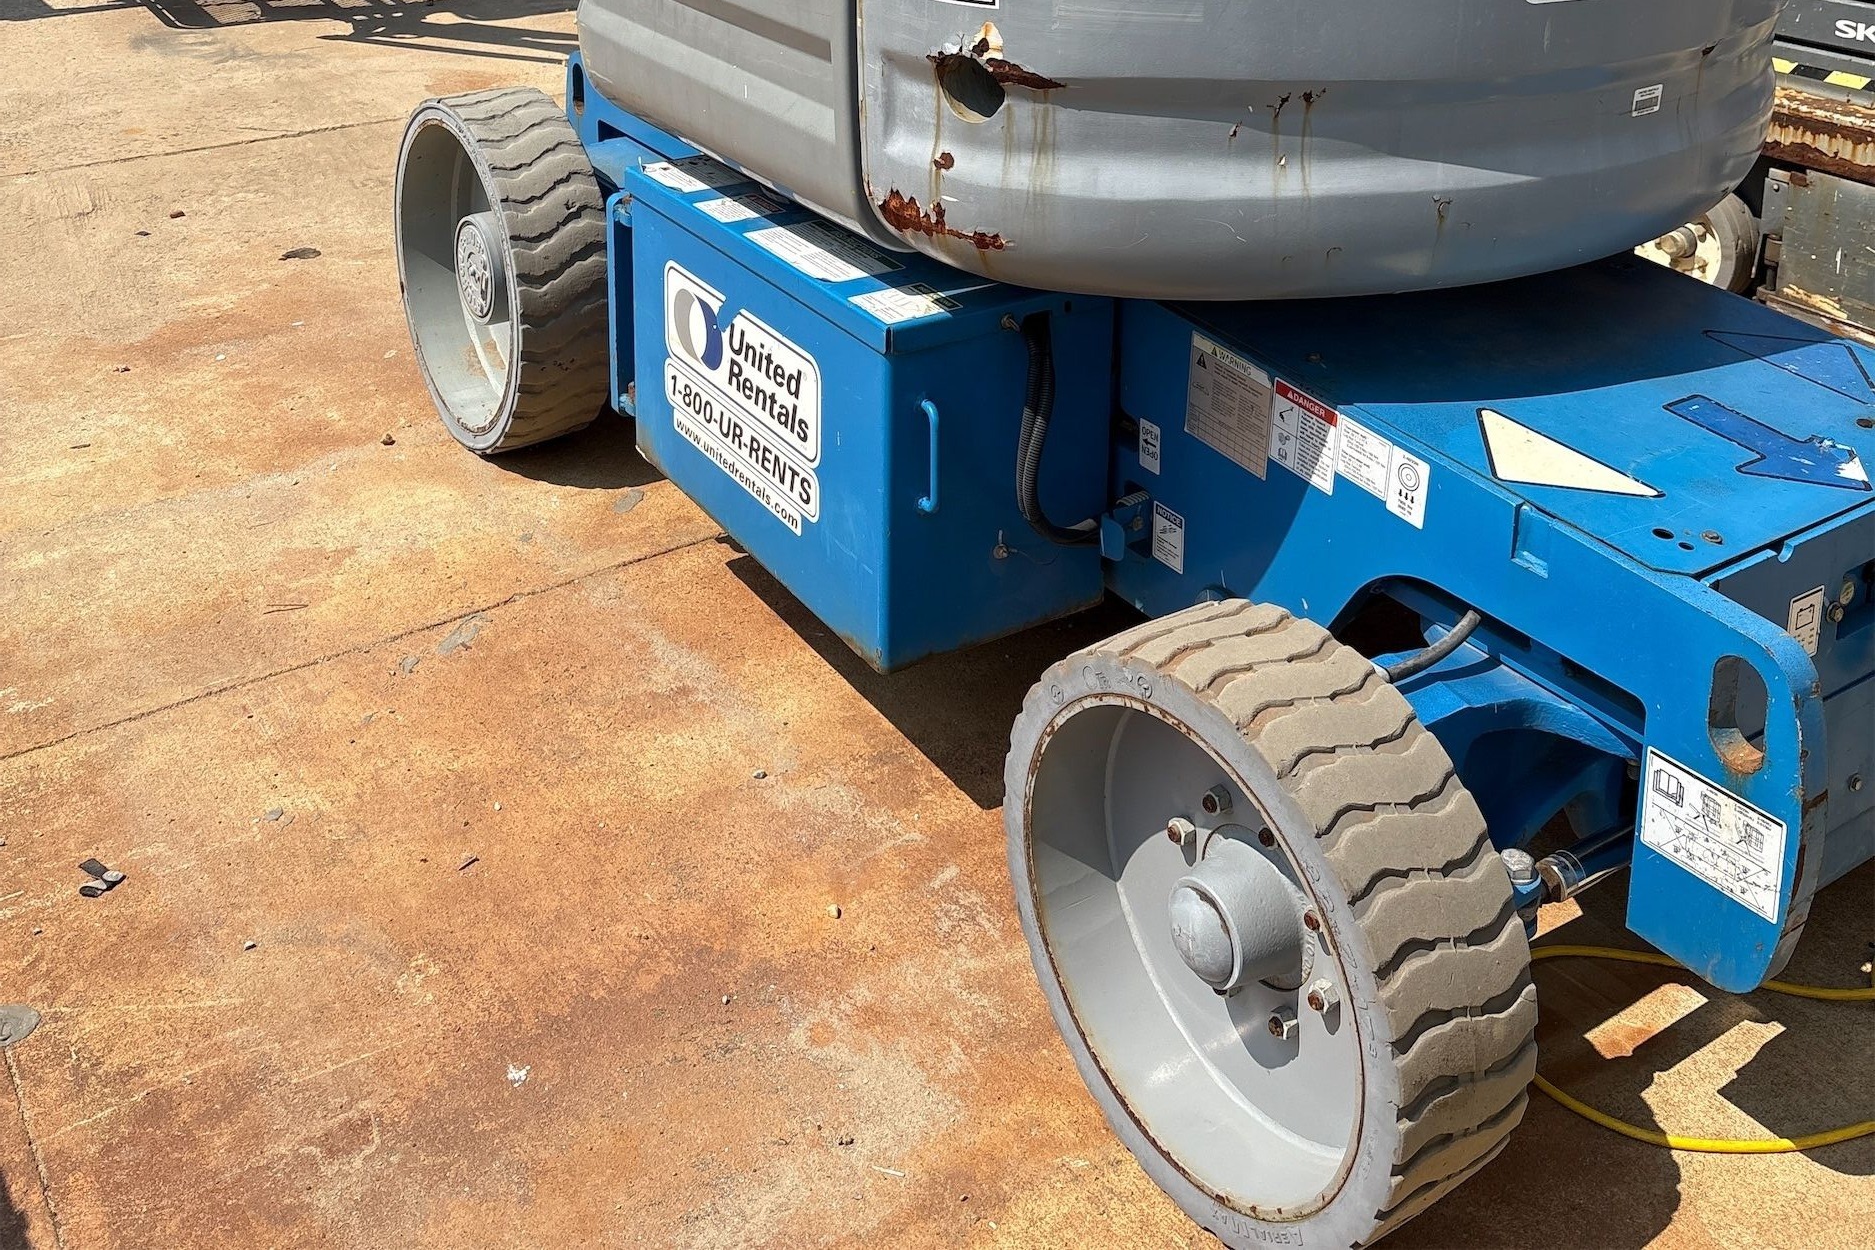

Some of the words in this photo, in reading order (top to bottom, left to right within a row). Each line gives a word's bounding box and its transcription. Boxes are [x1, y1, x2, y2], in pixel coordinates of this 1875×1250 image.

[729, 324, 802, 400] United
[1218, 351, 1252, 376] WARNING
[727, 359, 809, 444] Rentals
[1294, 392, 1325, 417] DANGER
[671, 374, 812, 505] 1-800-UR-RENTS
[1142, 427, 1159, 442] OPEN
[676, 417, 798, 529] www.unitedrentals.com
[1157, 506, 1182, 526] NOTICE
